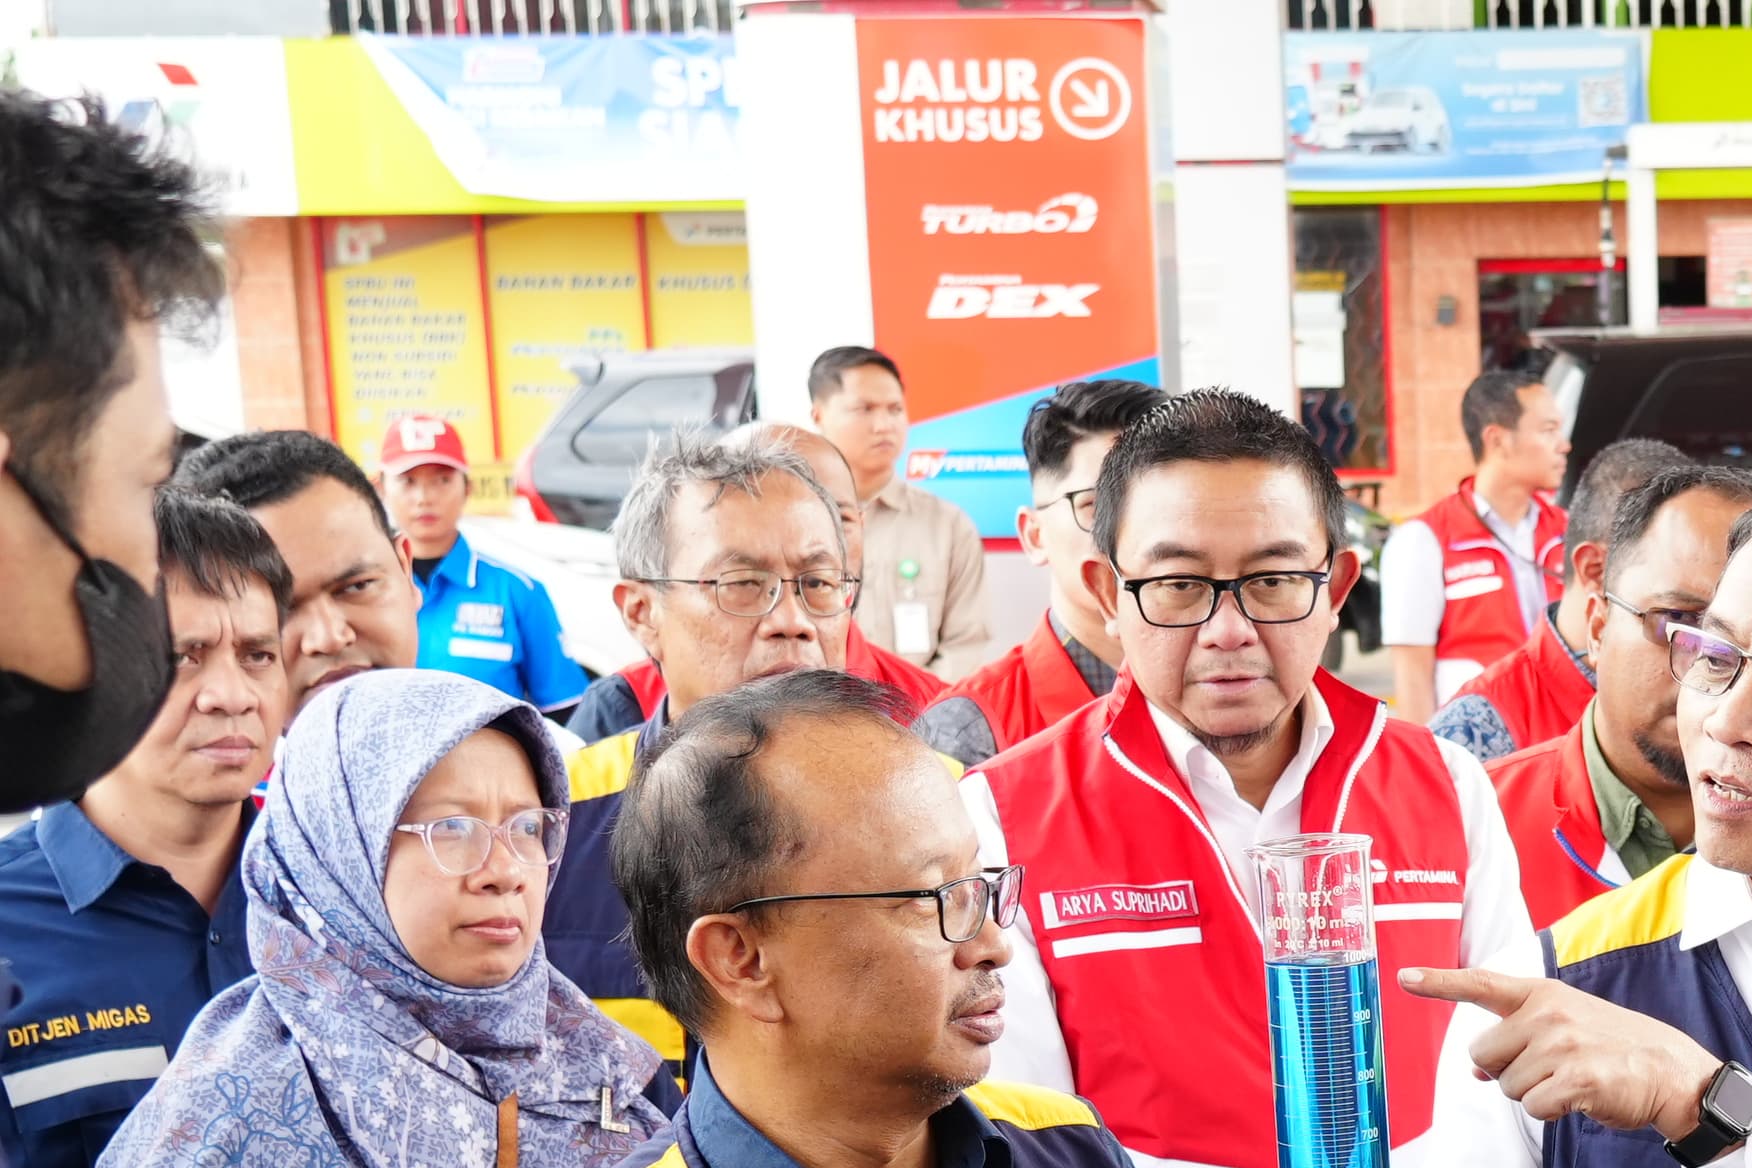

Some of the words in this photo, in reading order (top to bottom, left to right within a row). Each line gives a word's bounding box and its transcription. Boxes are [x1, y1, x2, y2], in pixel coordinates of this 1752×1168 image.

[874, 58, 1041, 104] JALUR
[874, 107, 1043, 143] KHUSUS
[496, 274, 564, 290] BAHAN
[571, 274, 637, 290] BAKAR
[926, 283, 1101, 320] DEX
[1394, 870, 1460, 884] PERTAMINA
[1062, 891, 1107, 917] ARYA
[1112, 889, 1187, 912] SUPRIHADI
[7, 1015, 81, 1048] DITJEN
[86, 1004, 151, 1031] MIGAS
[1353, 1009, 1371, 1022] 900
[1357, 1069, 1375, 1082] 800
[1361, 1128, 1379, 1141] 700
